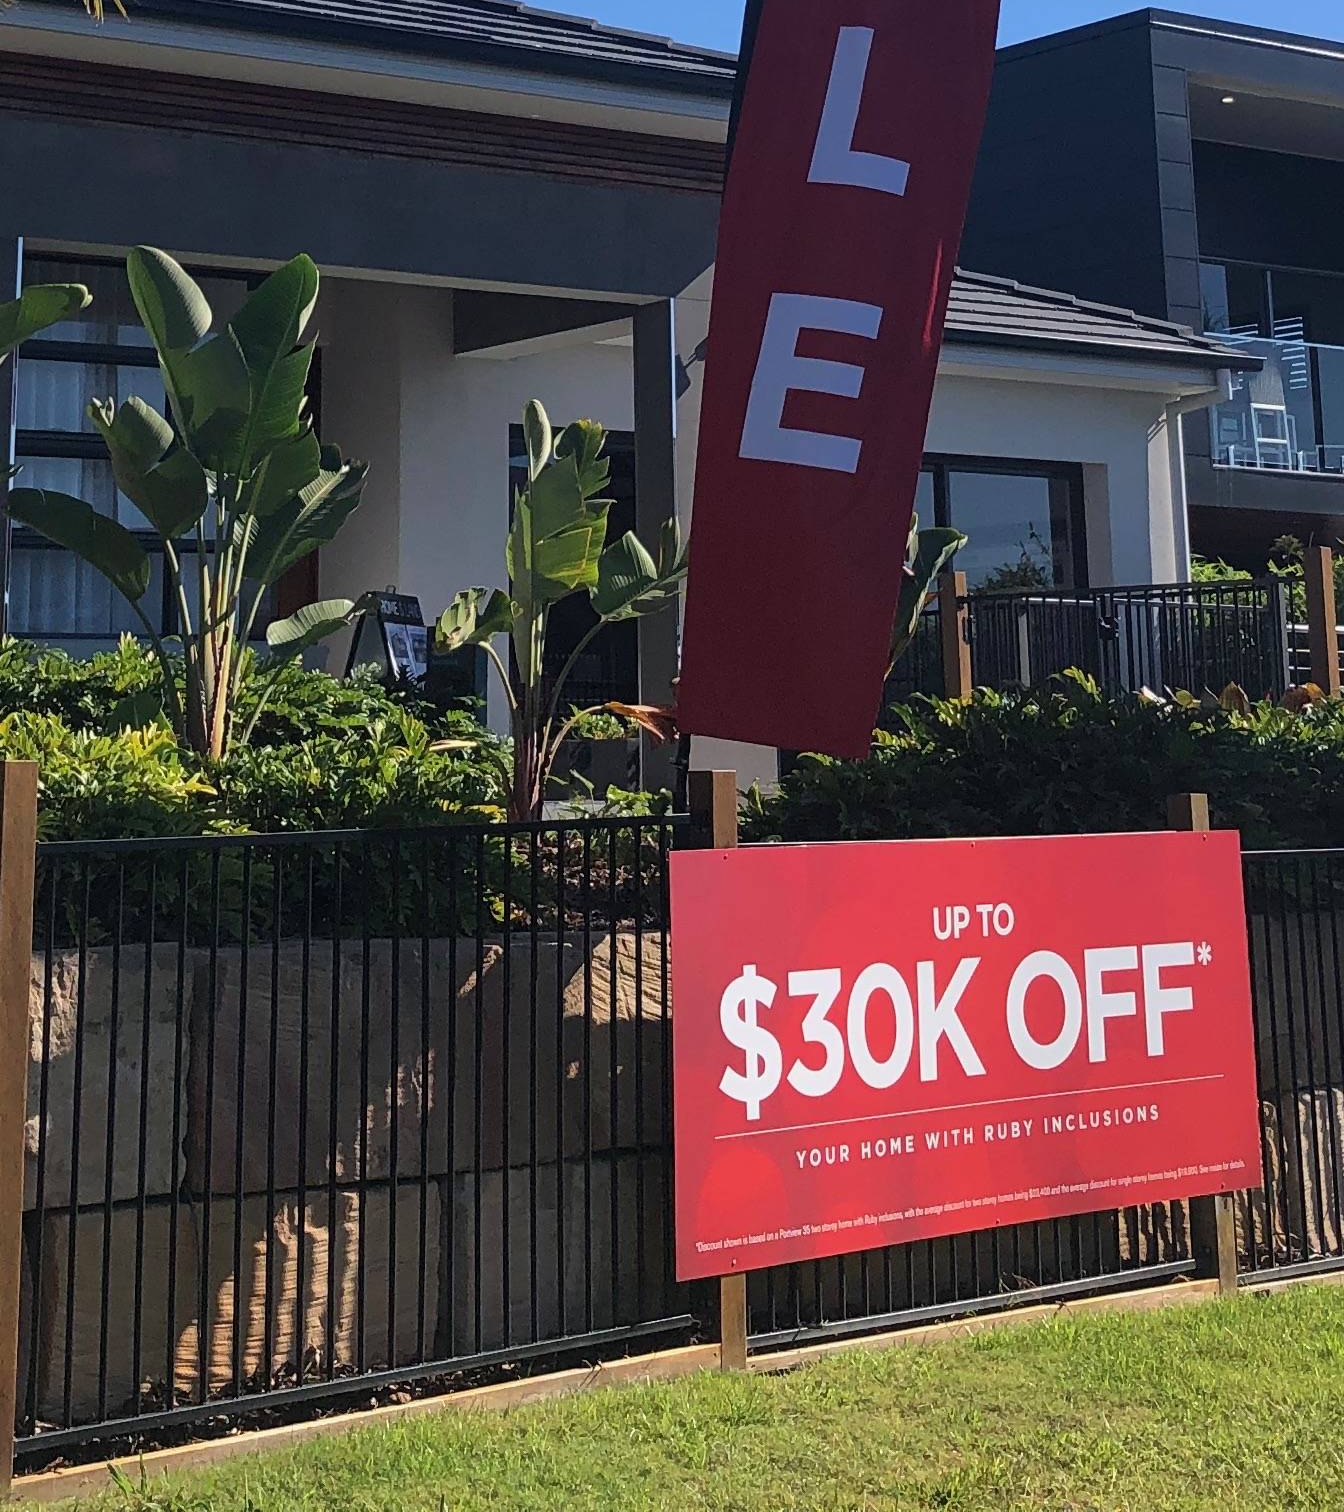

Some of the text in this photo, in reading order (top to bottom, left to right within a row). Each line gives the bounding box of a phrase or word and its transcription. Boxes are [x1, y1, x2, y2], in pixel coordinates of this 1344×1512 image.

[932, 903, 1015, 941] UP TO
[718, 956, 987, 1121] $30K
[796, 1104, 1160, 1169] YOUR HOME WITH RUBY INCLUSIONS
